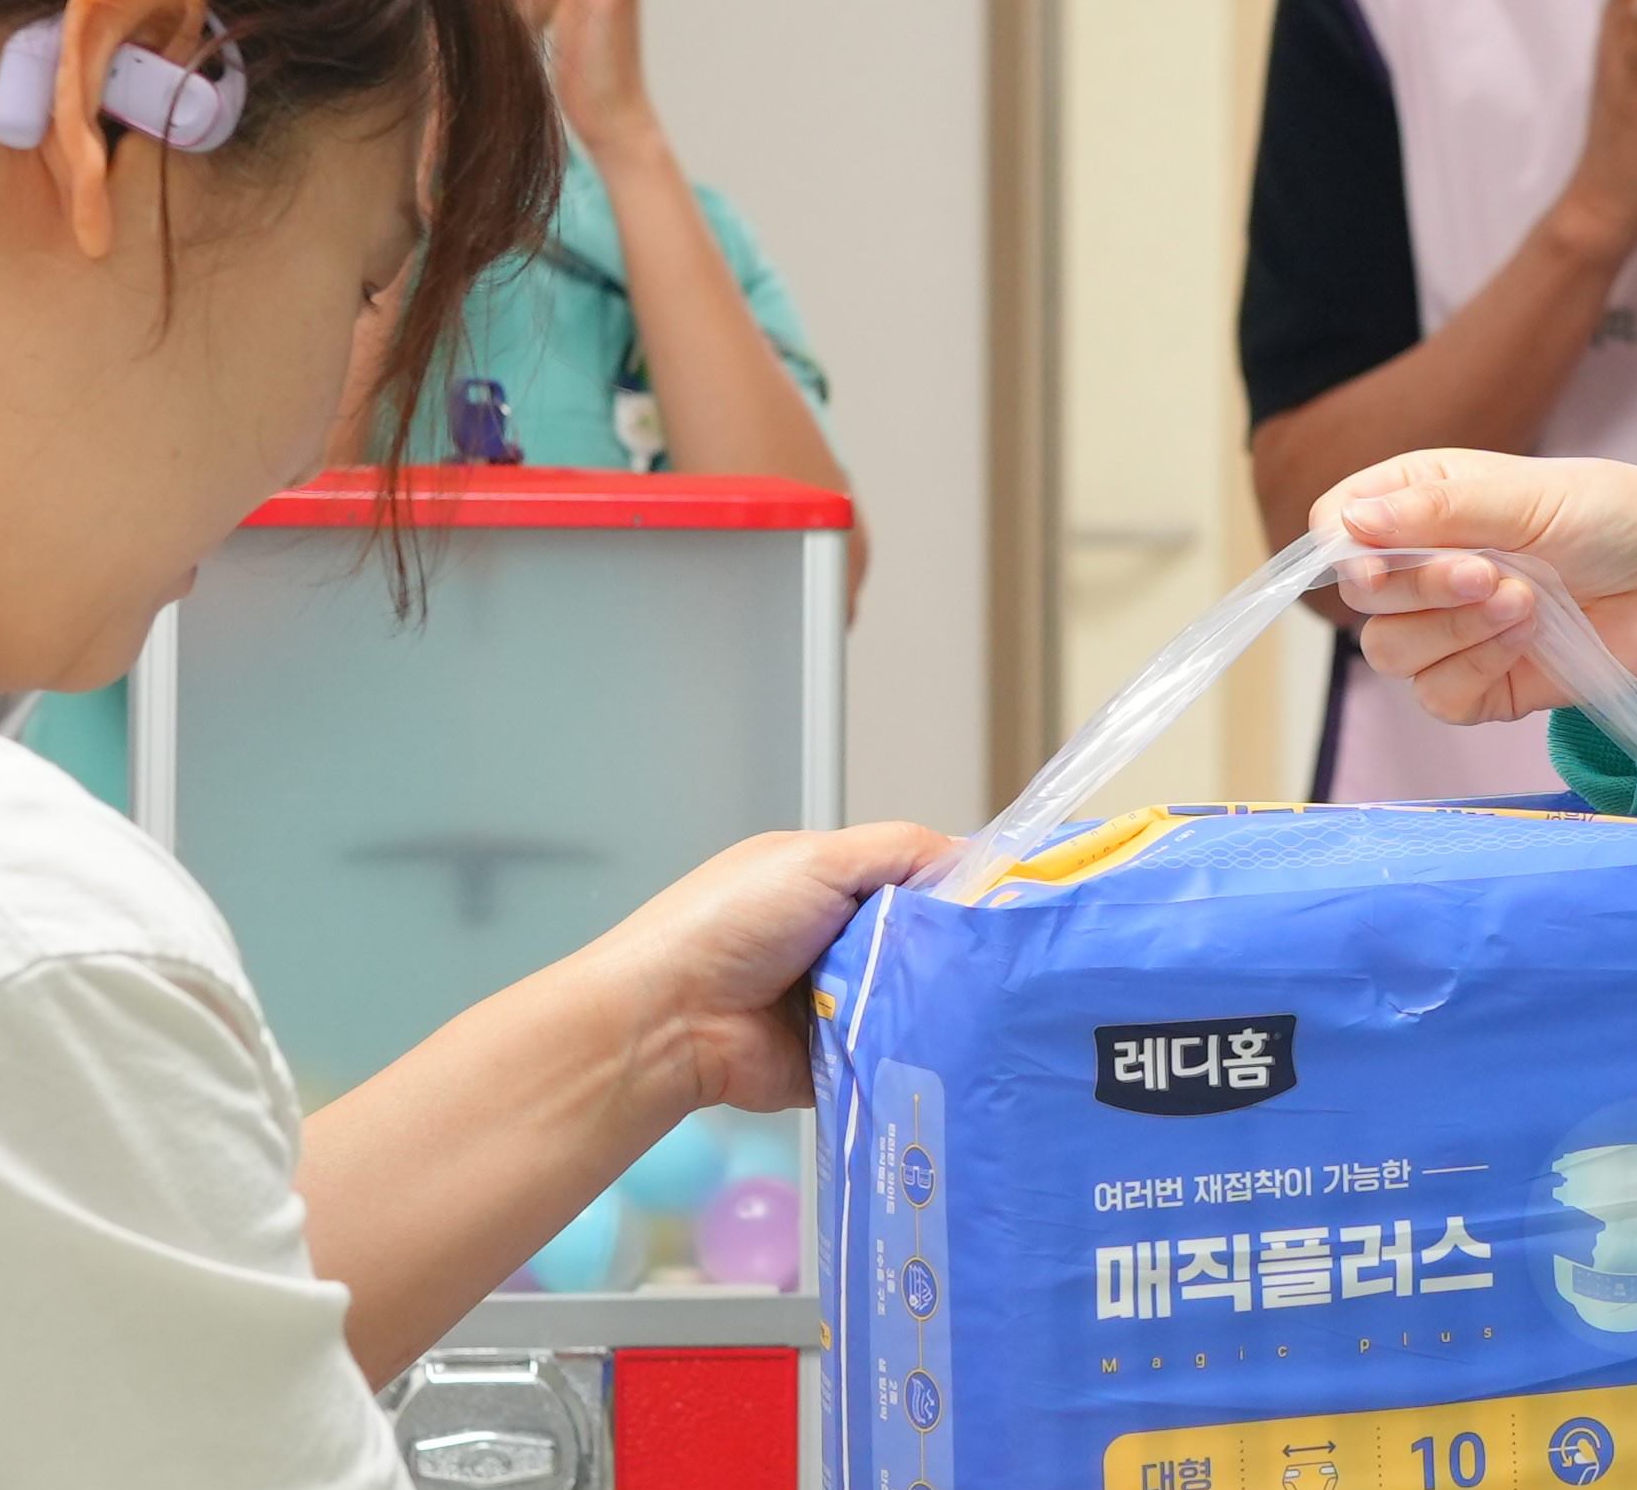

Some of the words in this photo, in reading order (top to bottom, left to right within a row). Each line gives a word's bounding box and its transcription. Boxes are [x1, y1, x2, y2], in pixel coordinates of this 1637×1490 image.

[1113, 1027, 1276, 1092] 레디홈
[1094, 1178, 1184, 1212] 여러번
[1194, 1165, 1313, 1204] 재접착이
[1322, 1158, 1412, 1196] 가능한
[1094, 1215, 1495, 1321] 매직플러스
[1101, 1344, 1289, 1373] Magic
[1359, 1324, 1494, 1354] plus
